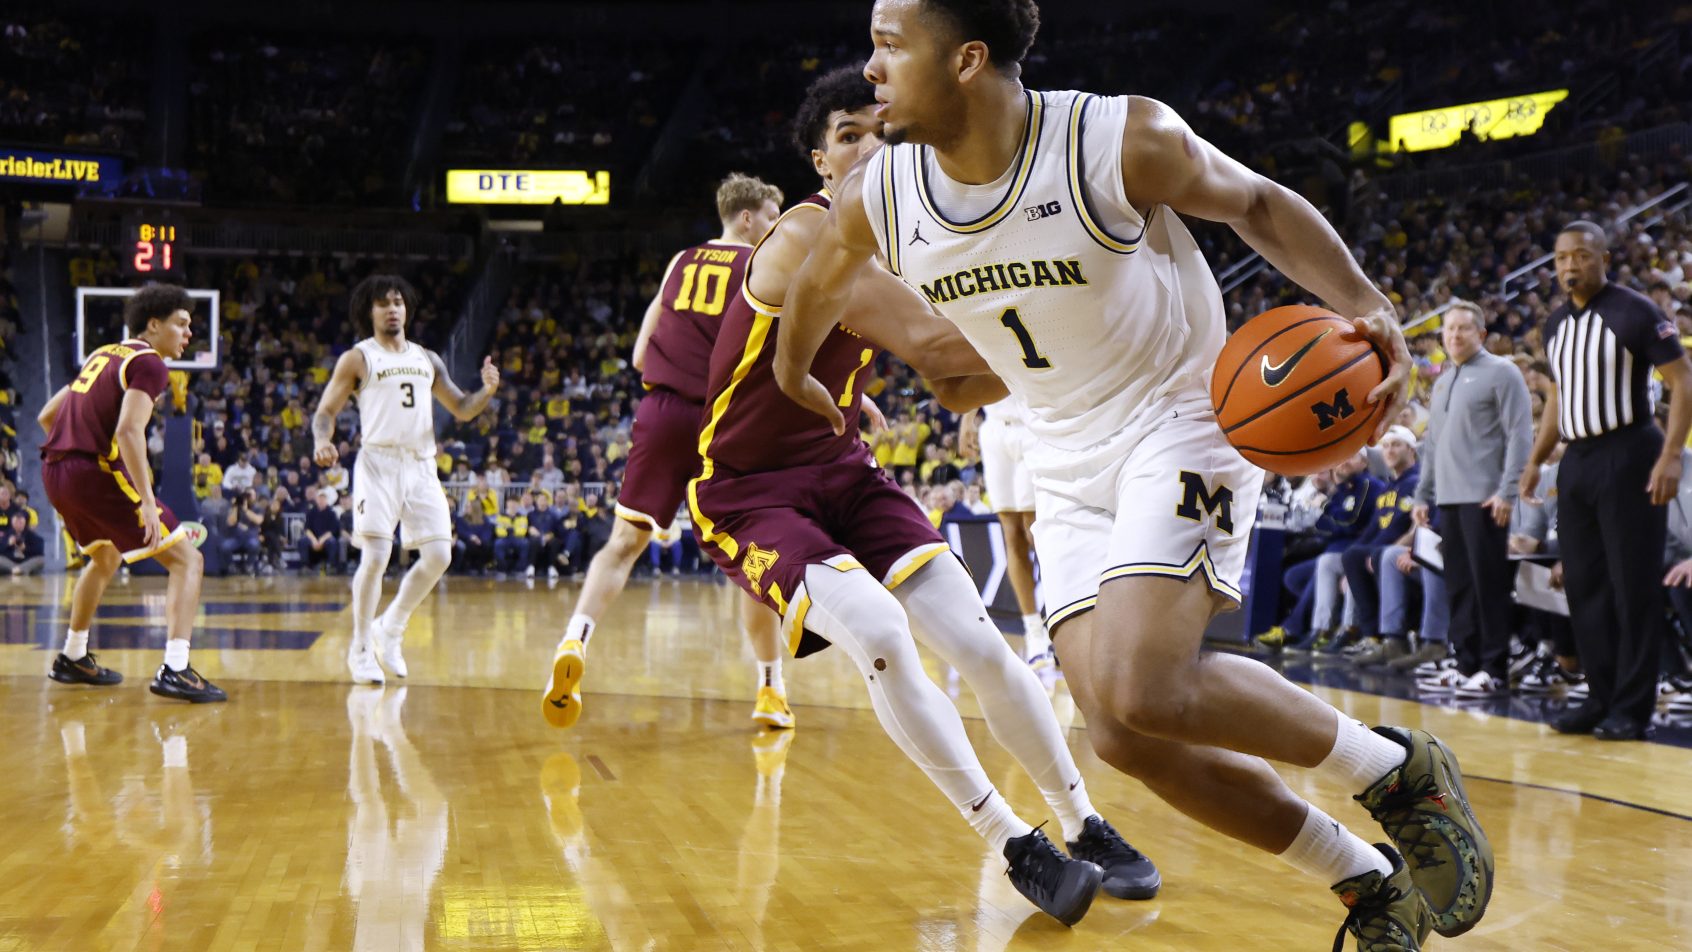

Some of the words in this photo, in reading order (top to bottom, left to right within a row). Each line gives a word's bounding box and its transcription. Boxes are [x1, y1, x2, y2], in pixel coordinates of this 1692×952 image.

[478, 174, 528, 191] DTE
[140, 223, 175, 242] 8:11
[134, 241, 171, 271] 21
[694, 248, 738, 264] TYSON
[673, 263, 732, 316] 10
[919, 259, 1089, 304] MICHIGAN
[998, 306, 1054, 369] 1
[71, 355, 110, 394] 9
[377, 367, 430, 381] MICHIGAN
[838, 348, 873, 407] 1
[400, 382, 415, 408] 3
[1310, 387, 1356, 431] M
[1176, 469, 1234, 536] M
